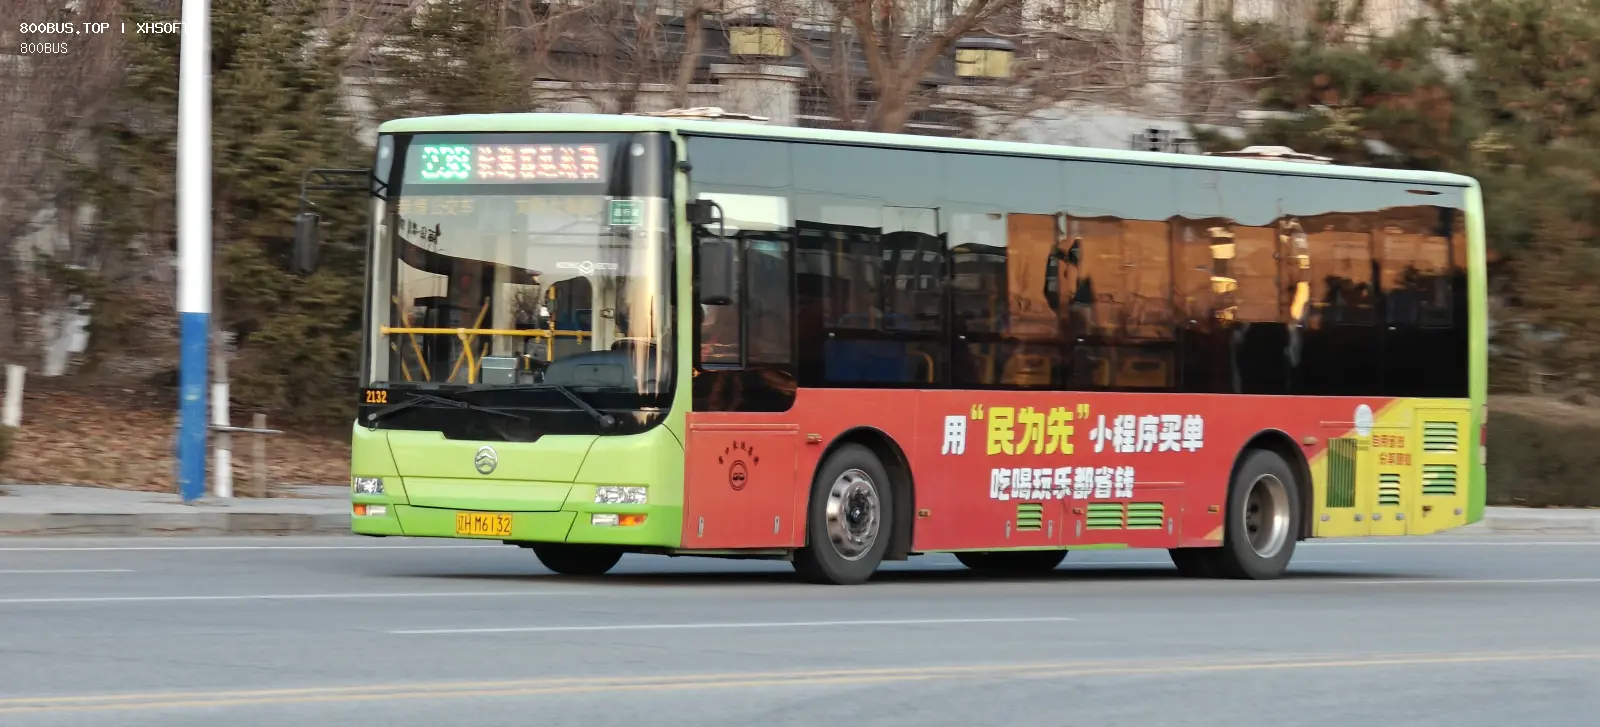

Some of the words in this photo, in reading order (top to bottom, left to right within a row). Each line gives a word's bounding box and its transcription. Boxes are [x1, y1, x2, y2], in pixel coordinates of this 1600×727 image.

[366, 390, 387, 403] 2132
[990, 466, 1136, 500] 吃喝玩乐都省钱
